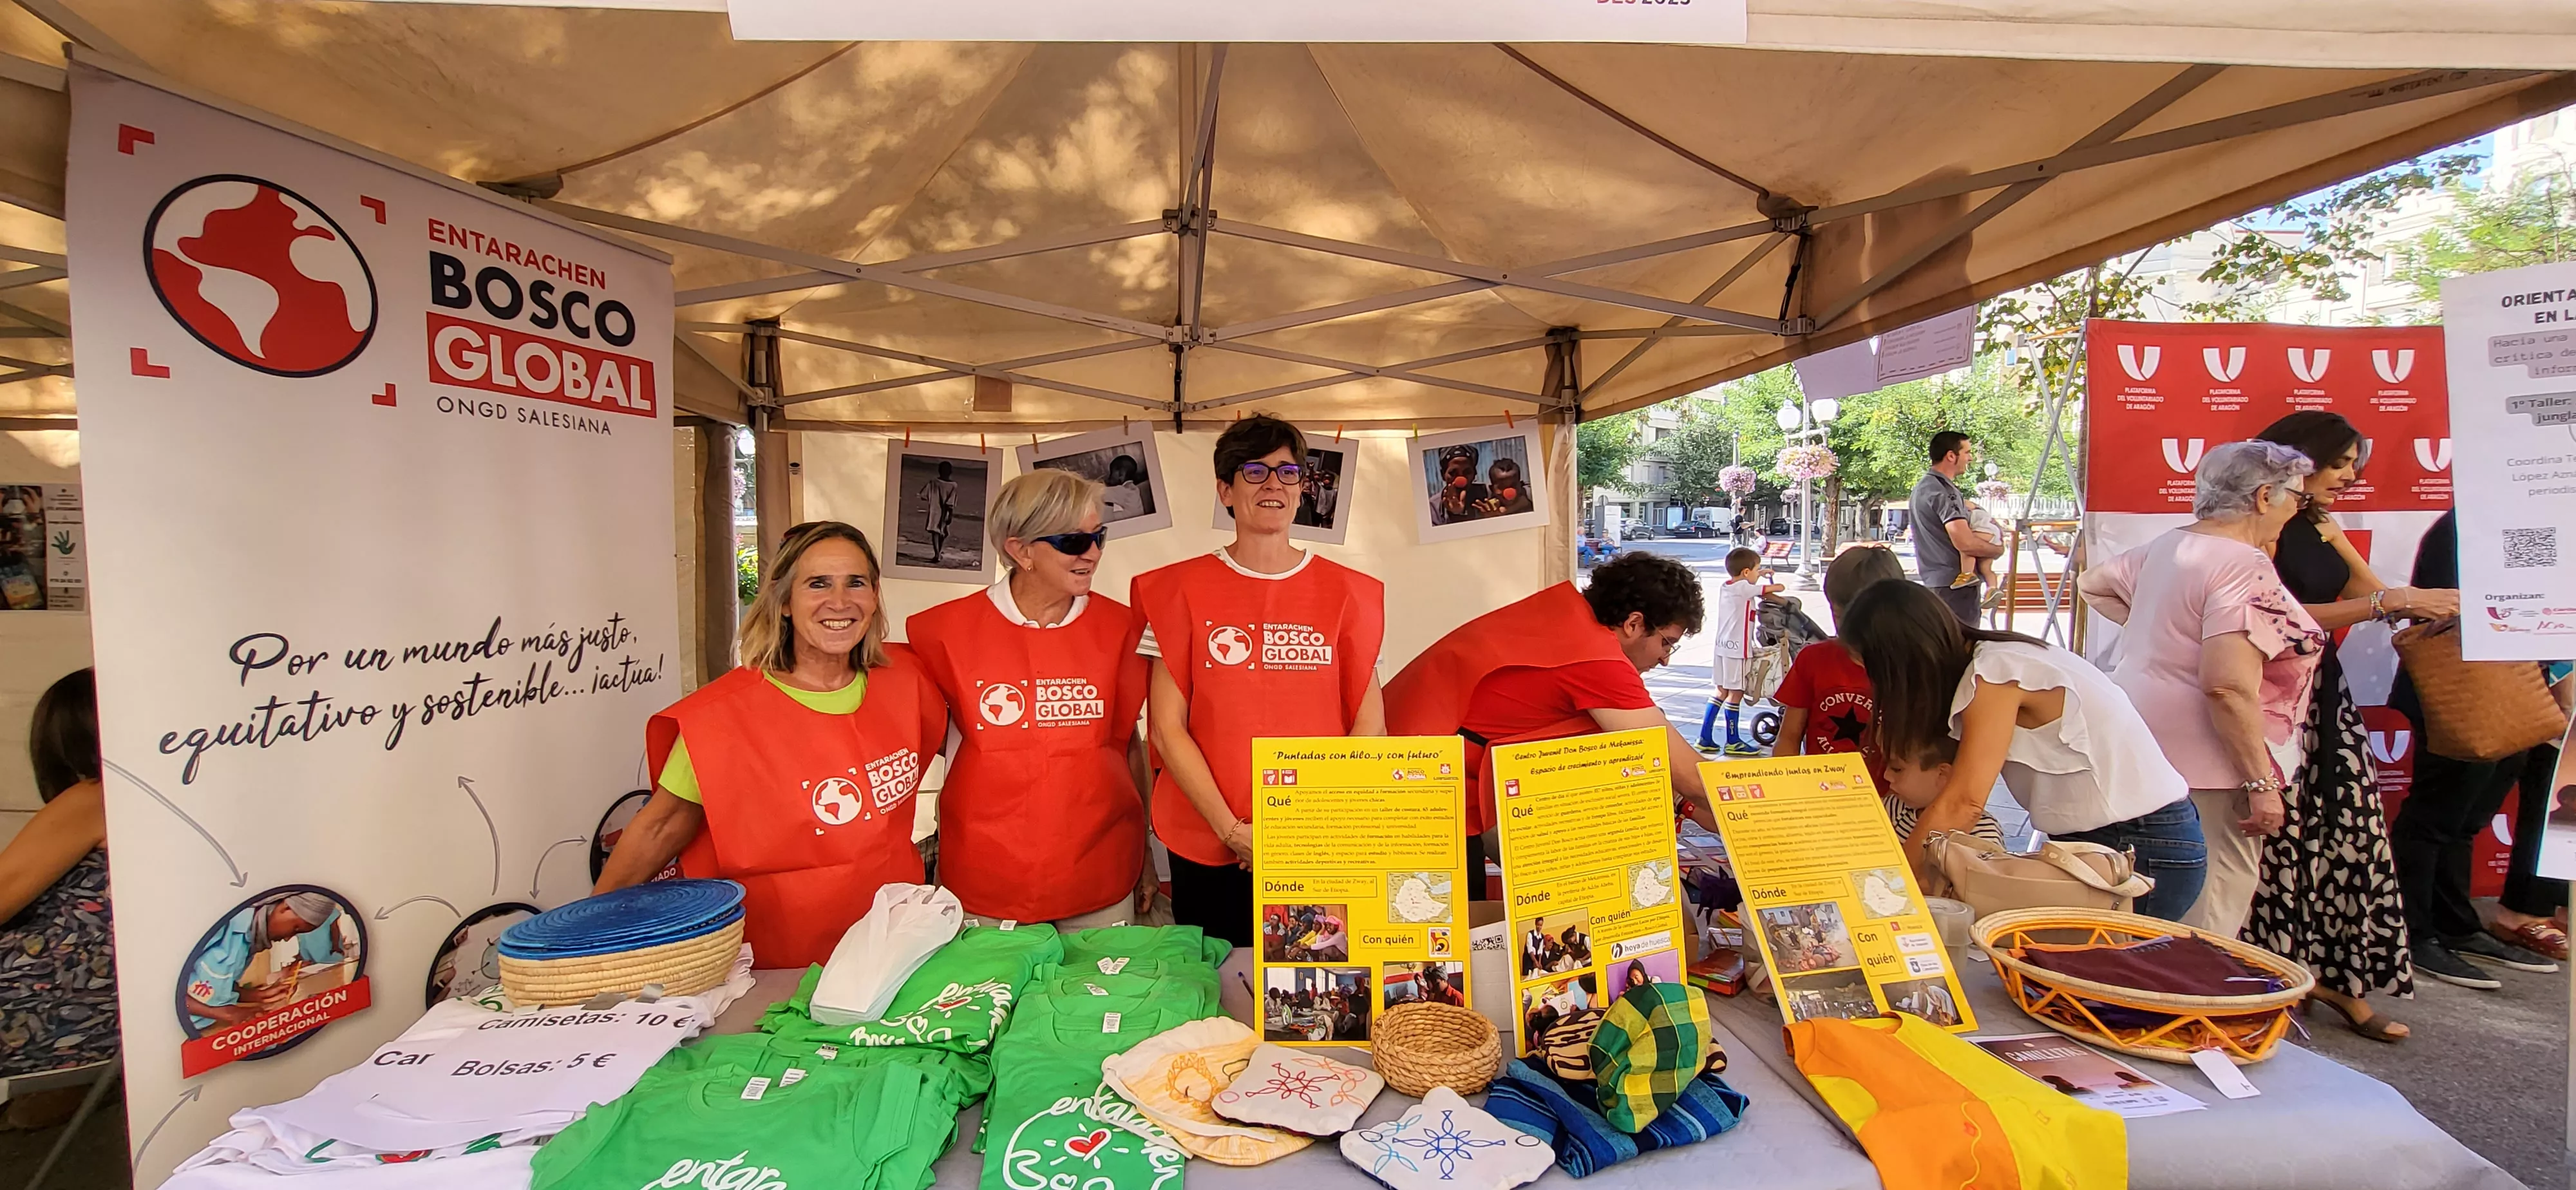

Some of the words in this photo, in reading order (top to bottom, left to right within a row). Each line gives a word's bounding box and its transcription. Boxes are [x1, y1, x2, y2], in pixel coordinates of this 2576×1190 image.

[429, 218, 607, 290] ENTARACHEN
[430, 250, 635, 348] BOSCO
[2535, 310, 2557, 323] EN
[2564, 309, 2576, 321] L
[2494, 337, 2535, 348] Hacia
[433, 325, 652, 411] GLOBAL
[437, 396, 507, 420] ONGD
[517, 407, 612, 435] SALESIANA
[2507, 456, 2562, 466] Coordina
[2512, 473, 2548, 483] López
[2485, 593, 2545, 602] Organizan:
[1263, 623, 1313, 632] ENTARACHEN
[1263, 630, 1325, 646] BOSCO
[229, 631, 328, 686] Por
[344, 647, 394, 670] un
[402, 615, 515, 665] mundo
[520, 620, 573, 658] más
[565, 610, 638, 674] justo,
[1265, 648, 1330, 661] GLOBAL
[1036, 685, 1098, 701] BOSCO
[1038, 703, 1102, 718] GLOBAL
[158, 690, 383, 786] equitativo
[385, 701, 415, 751] y
[591, 653, 663, 694] ¡actúa!
[865, 747, 909, 771] ENTARACHEN
[1539, 748, 1561, 759] Juvenil
[1579, 744, 1597, 753] Bosco
[867, 752, 918, 788] BOSCO
[1531, 766, 1556, 775] Espacio
[1567, 760, 1602, 770] crecimiento
[1786, 767, 1811, 776] juntas
[876, 770, 918, 803] GLOBAL
[1267, 795, 1292, 808] Qué
[1511, 804, 1533, 819] Qué
[1727, 811, 1748, 822] Qué
[1264, 880, 1305, 892] Dónde
[1752, 887, 1786, 900] Dónde
[1516, 891, 1550, 905] Dónde
[1590, 916, 1605, 925] Con
[1608, 909, 1631, 922] quién
[1362, 935, 1382, 944] Con
[1385, 934, 1414, 945] quién
[1857, 932, 1878, 943] Con
[1867, 953, 1897, 967] quién
[211, 989, 348, 1051] COOPERACIÓN
[478, 1012, 625, 1030] Camisetas:
[634, 1014, 668, 1027] 10
[674, 1015, 693, 1028] €
[233, 1012, 330, 1057] INTERNACIONAL
[374, 1051, 435, 1066] Car
[451, 1058, 562, 1077] Bolsas:
[567, 1053, 591, 1068] 5
[593, 1053, 617, 1068] €
